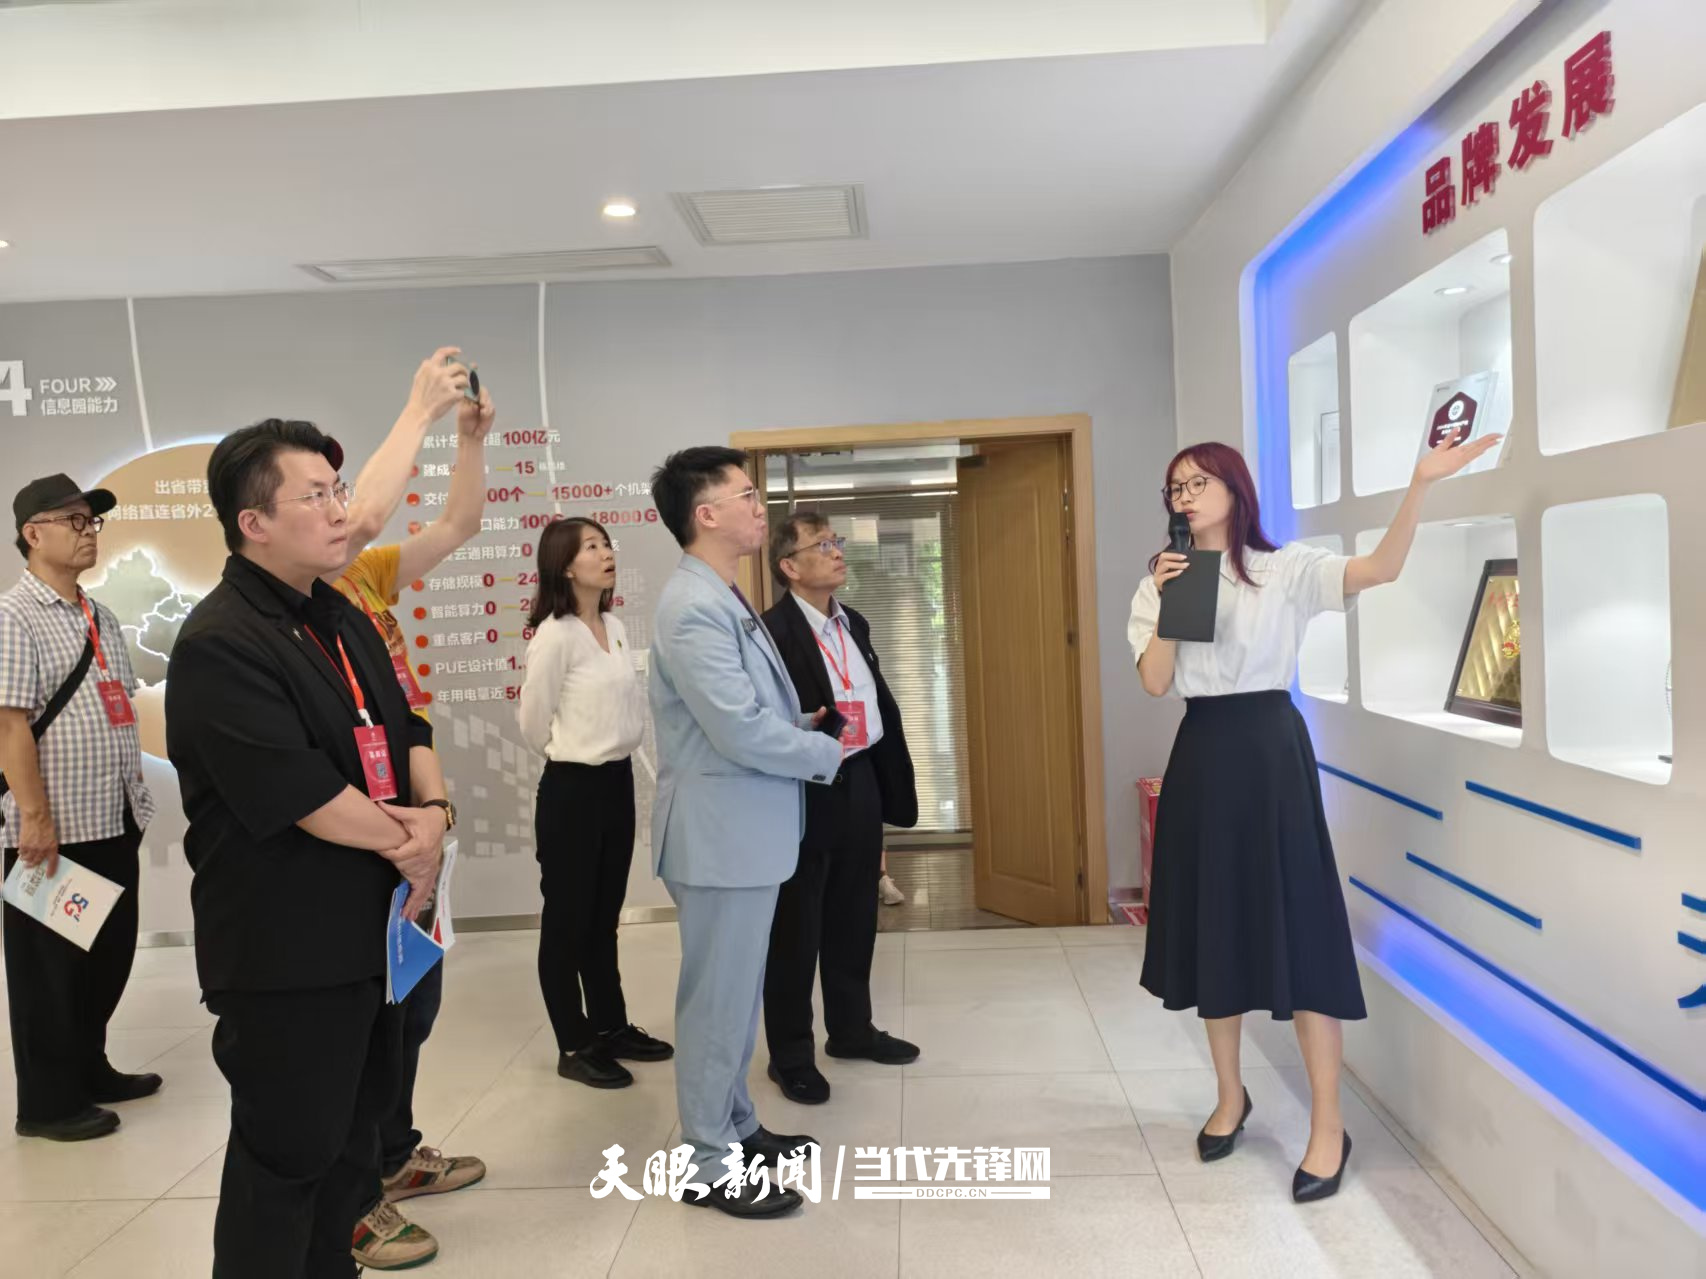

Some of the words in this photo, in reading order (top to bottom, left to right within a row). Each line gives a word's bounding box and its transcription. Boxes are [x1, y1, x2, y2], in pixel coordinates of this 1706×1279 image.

[1422, 31, 1615, 234] 品牌发展
[40, 378, 91, 394] FOUR
[515, 461, 535, 474] 15
